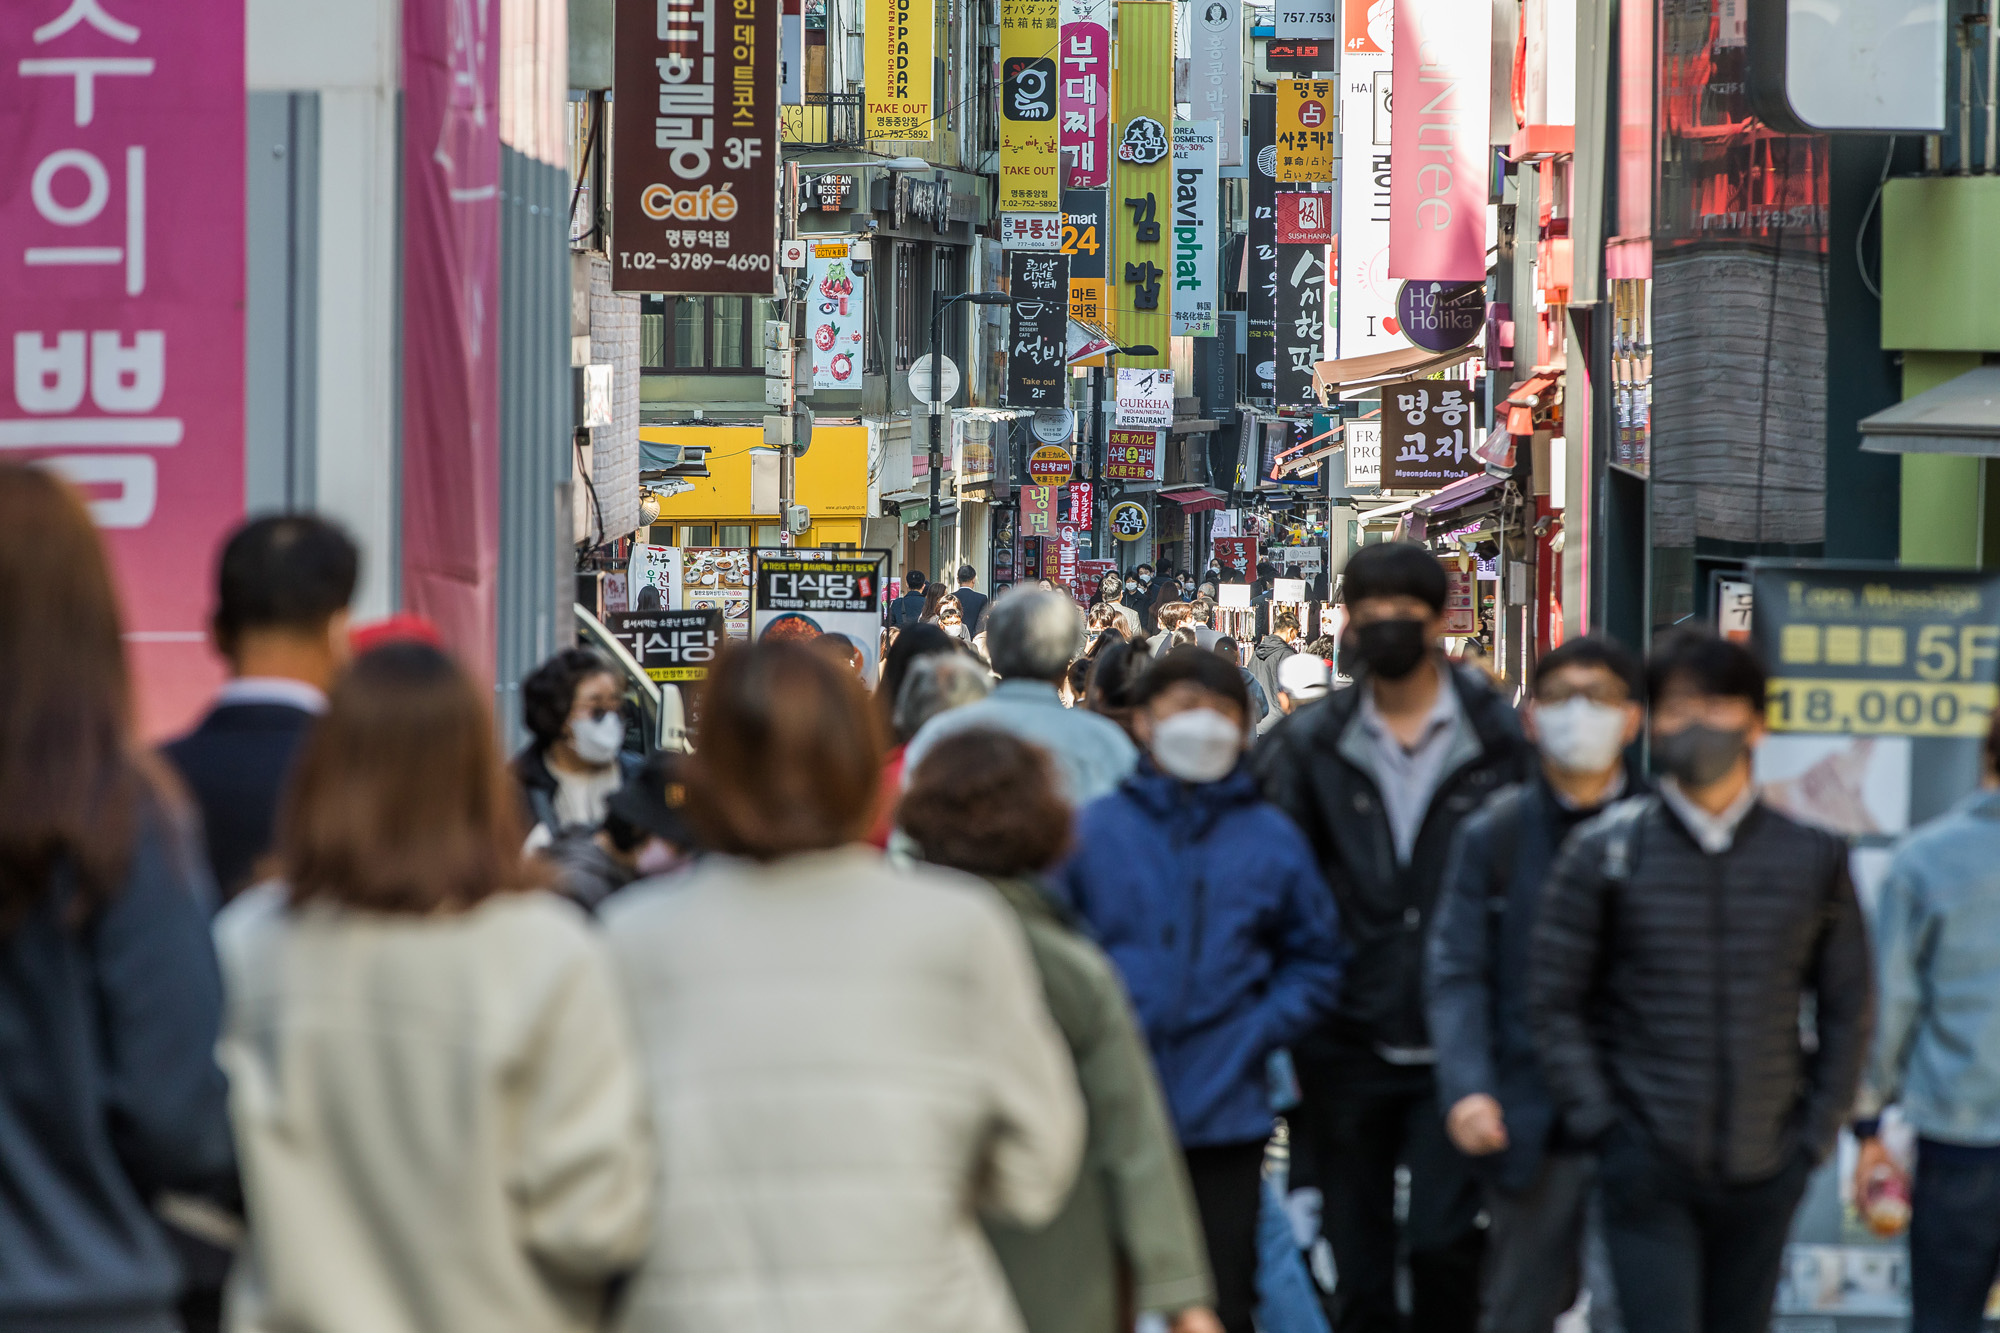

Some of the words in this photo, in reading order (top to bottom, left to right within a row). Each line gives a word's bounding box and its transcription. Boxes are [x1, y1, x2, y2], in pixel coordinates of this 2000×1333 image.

[1003, 4, 1058, 16] オパダック
[887, 25, 895, 56] BAKED
[1347, 37, 1365, 49] 4F
[896, 0, 911, 99] OPPADAK
[887, 58, 895, 98] CHICKEN
[1293, 82, 1329, 99] 명동
[868, 103, 899, 114] TAKE
[902, 103, 928, 114] OUT
[1061, 34, 1099, 173] 부대찌개
[1302, 103, 1321, 124] 占
[877, 116, 919, 128] 명동중앙점
[866, 129, 929, 139] T.02-752-5892
[724, 137, 762, 170] 3F
[1172, 151, 1189, 159] ALE
[1003, 166, 1031, 175] TAKE
[1033, 166, 1056, 176] OUT
[821, 175, 852, 185] KOREAN
[1074, 176, 1092, 187] 2F
[817, 185, 850, 195] DESSERT
[1010, 189, 1048, 198] 명동중앙점
[640, 183, 739, 222] Café
[821, 195, 841, 205] CAFE
[1002, 199, 1058, 208] T.02-752-5892
[1061, 212, 1098, 225] emart
[1003, 217, 1014, 242] 동우
[1013, 219, 1060, 240] 부동산
[1174, 168, 1204, 291] baviphat
[665, 229, 731, 249] 명동역점
[1060, 225, 1100, 256] 24
[1288, 232, 1307, 240] SUSHI
[1308, 232, 1332, 240] HANPA
[1124, 192, 1164, 309] 김밥
[619, 251, 772, 272] T.02-3789-4690
[1026, 258, 1058, 271] 코리안
[1023, 271, 1054, 282] 디저트
[1031, 280, 1057, 290] 카페
[1196, 301, 1212, 310] 韩国
[1409, 309, 1474, 330] Holika
[1184, 322, 1201, 331] 7~3
[1014, 335, 1064, 367] 설빙
[1021, 377, 1041, 386] Take
[1043, 378, 1056, 386] out
[1159, 373, 1172, 383] 5F
[1031, 388, 1046, 399] 2F
[1119, 397, 1170, 409] GURKHA
[1396, 389, 1469, 425] 명동
[1123, 408, 1166, 416] INDIAN/NEPALI
[1121, 415, 1167, 425] RESTAURANT
[1395, 429, 1468, 465] 교자
[1032, 461, 1070, 472] 수원왕갈비
[1395, 469, 1442, 478] Myeongdong
[1028, 486, 1050, 533] 냉면
[646, 551, 671, 569] 한우
[769, 573, 856, 600] 더식당
[659, 618, 681, 628] 소문난
[614, 630, 719, 663] 더식당
[1914, 625, 1999, 681] 5F
